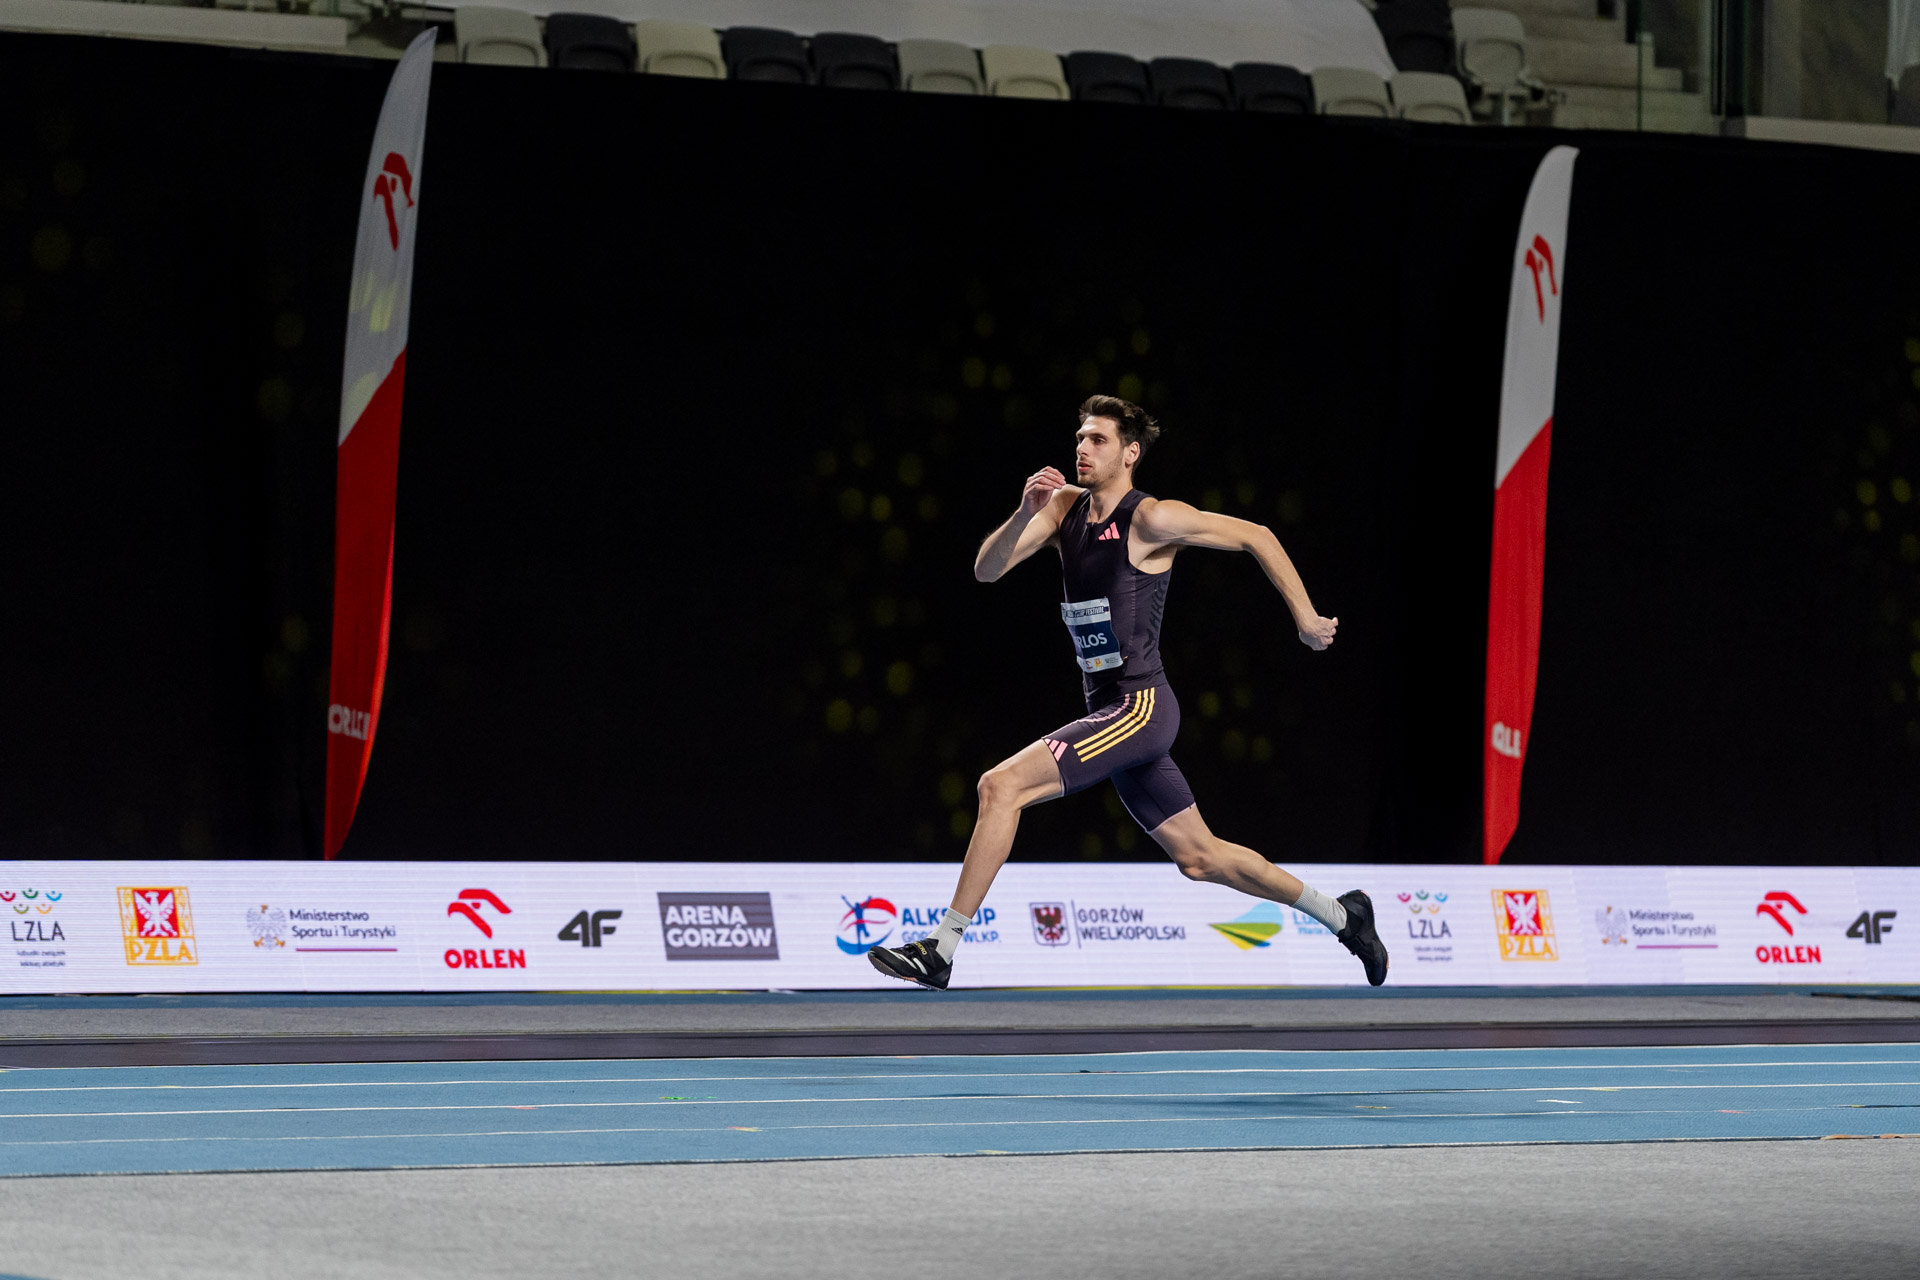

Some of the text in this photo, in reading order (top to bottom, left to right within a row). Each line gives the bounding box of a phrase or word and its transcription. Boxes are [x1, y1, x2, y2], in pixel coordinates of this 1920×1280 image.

[289, 909, 369, 921] Ministerstwo
[665, 905, 747, 925] ARENA
[1077, 905, 1144, 923] GORZÓW
[1629, 910, 1694, 921] Ministerstwo
[11, 921, 65, 941] LZLA
[292, 925, 333, 939] Sportu
[341, 925, 396, 939] Turystyki
[557, 910, 622, 947] 4F
[666, 924, 772, 948] GORZÓW
[1079, 926, 1186, 941] WIELKOPOLSKI
[1408, 919, 1452, 938] LZLA
[1632, 924, 1665, 938] Sportu
[1672, 924, 1717, 938] Turystyki
[1846, 910, 1897, 945] 4F
[129, 940, 193, 961] PZLA
[1502, 935, 1553, 956] PZLA
[1755, 945, 1822, 964] ORLEN
[444, 949, 526, 968] ORLEN
